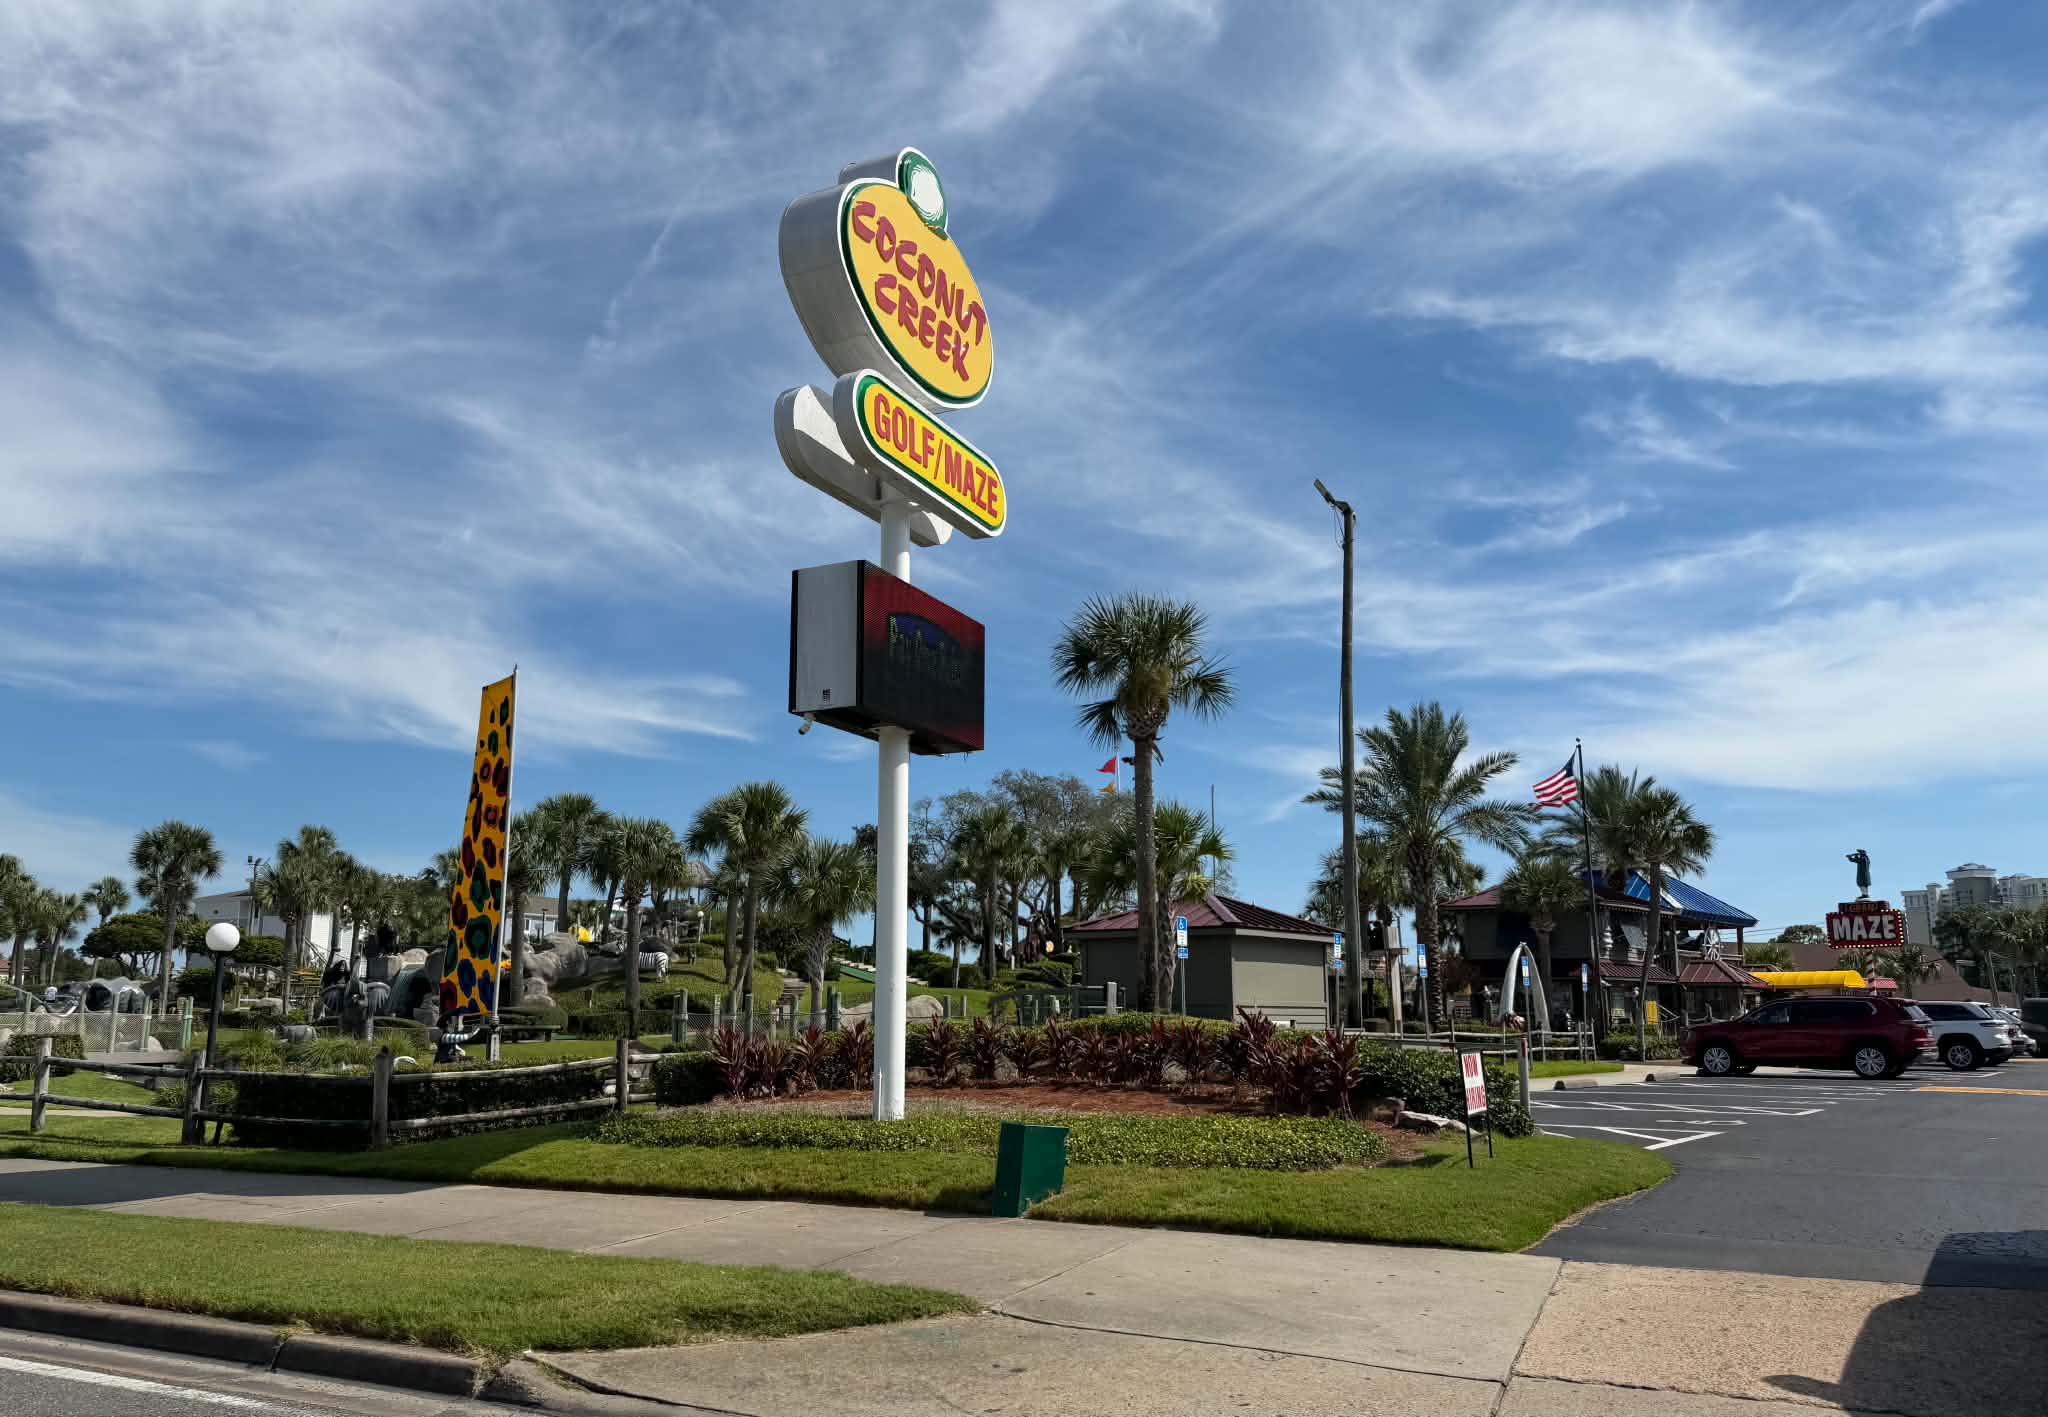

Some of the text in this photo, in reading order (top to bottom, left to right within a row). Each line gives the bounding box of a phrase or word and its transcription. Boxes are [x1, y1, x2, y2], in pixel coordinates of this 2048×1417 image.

[852, 201, 986, 346] COCONUT
[875, 273, 969, 381] CREEK
[874, 393, 998, 518] GOLF/MAZE
[1832, 915, 1897, 941] MAZE
[1463, 1055, 1478, 1078] NOW
[1466, 1085, 1486, 1111] HIRING
